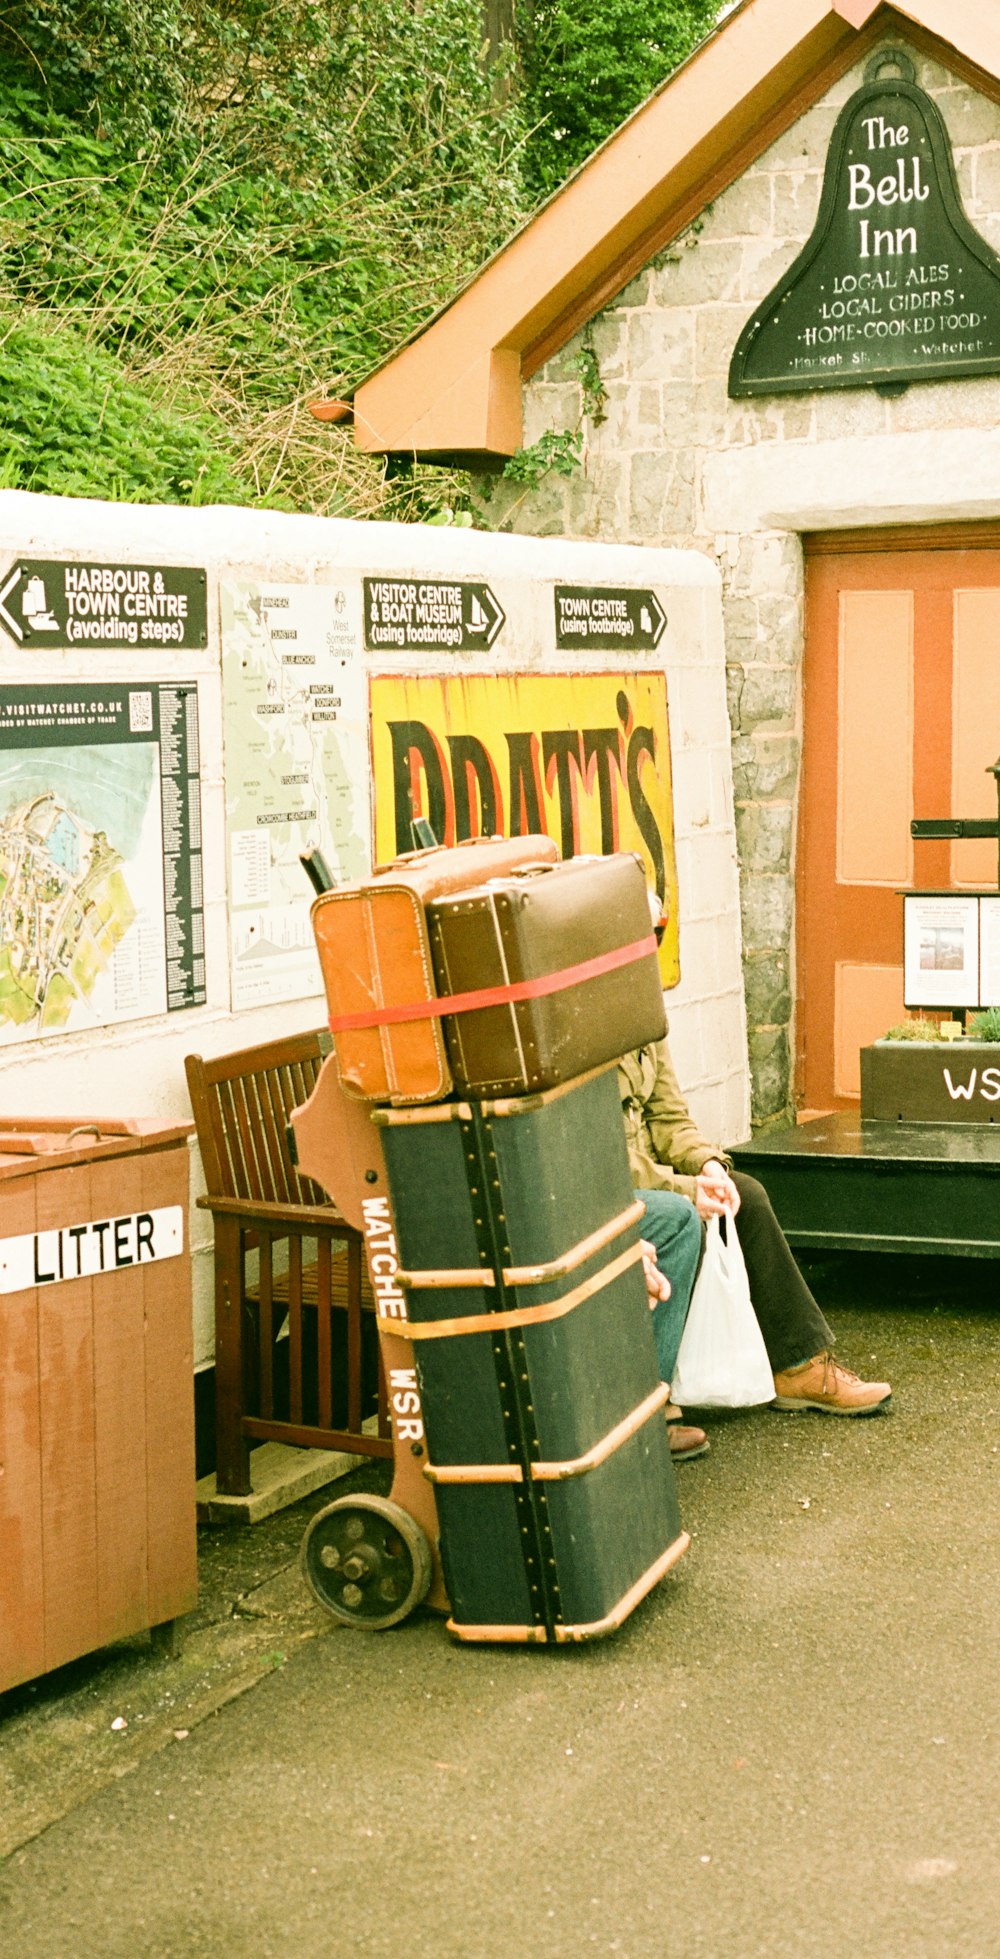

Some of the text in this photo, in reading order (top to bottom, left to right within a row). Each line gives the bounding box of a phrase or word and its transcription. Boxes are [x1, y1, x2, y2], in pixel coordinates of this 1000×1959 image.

[862, 116, 909, 150] The
[848, 156, 929, 210] Bell
[859, 220, 918, 258] Inn
[833, 264, 949, 294] LOCAL ALES
[822, 297, 881, 319] LOCAL
[940, 312, 981, 331] FOOD
[65, 568, 165, 594] HARBOUR &
[65, 592, 188, 617] TOWN CENTRE
[370, 582, 462, 605] VISITOR CENTRE
[370, 603, 462, 624] & BOAT MUSEUM
[559, 598, 627, 618] TOWN CENTRE
[66, 617, 185, 643] (avoiding steps)
[272, 630, 297, 639] DUNSTER
[332, 620, 349, 631] West
[371, 624, 463, 646] (using footbridge)
[560, 617, 634, 636] (using footbridge)
[326, 633, 356, 645] Somerset
[282, 655, 316, 664] BLUE ANCHOR
[329, 646, 354, 660] Railway
[311, 685, 333, 694] WATCHET
[943, 1067, 1000, 1101] WS
[34, 1213, 155, 1283] LITTER
[361, 1196, 424, 1440] WATCHE WSR
